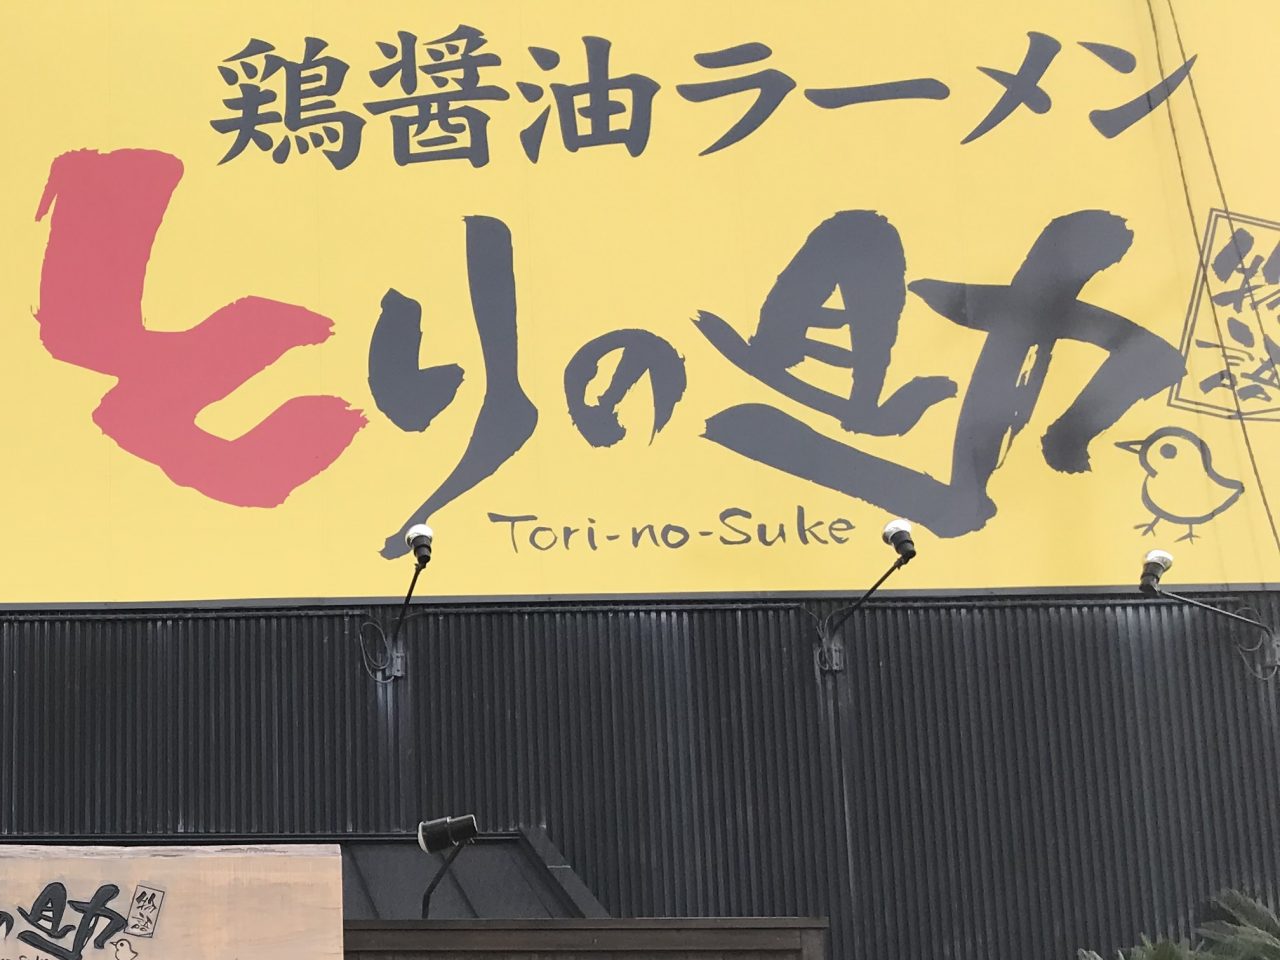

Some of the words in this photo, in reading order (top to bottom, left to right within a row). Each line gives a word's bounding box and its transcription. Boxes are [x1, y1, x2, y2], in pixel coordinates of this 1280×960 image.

[210, 25, 1198, 171] 鶏醤油ラーメン
[34, 148, 1187, 559] とりの助
[488, 510, 856, 552] Tori-no-Suke
